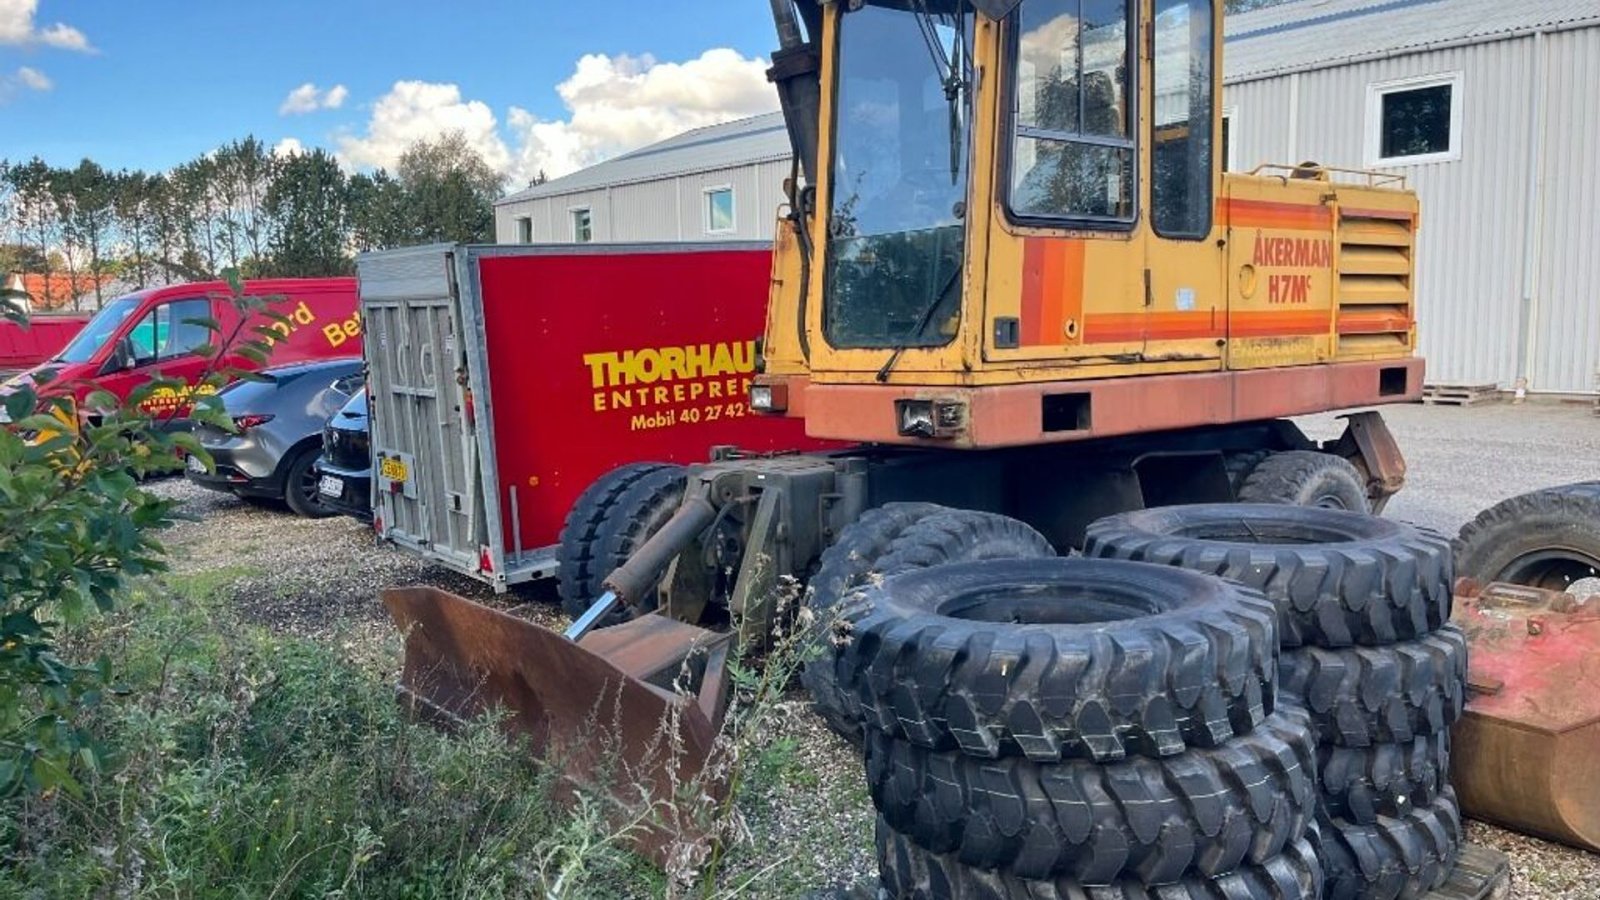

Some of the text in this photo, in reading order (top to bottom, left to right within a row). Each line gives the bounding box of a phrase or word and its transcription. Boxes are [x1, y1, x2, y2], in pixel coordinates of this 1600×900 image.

[1253, 228, 1331, 267] ÅKERMAN
[631, 409, 676, 431] Mobil
[679, 408, 701, 423] 40
[705, 404, 723, 421] 27
[725, 402, 745, 418] 42
